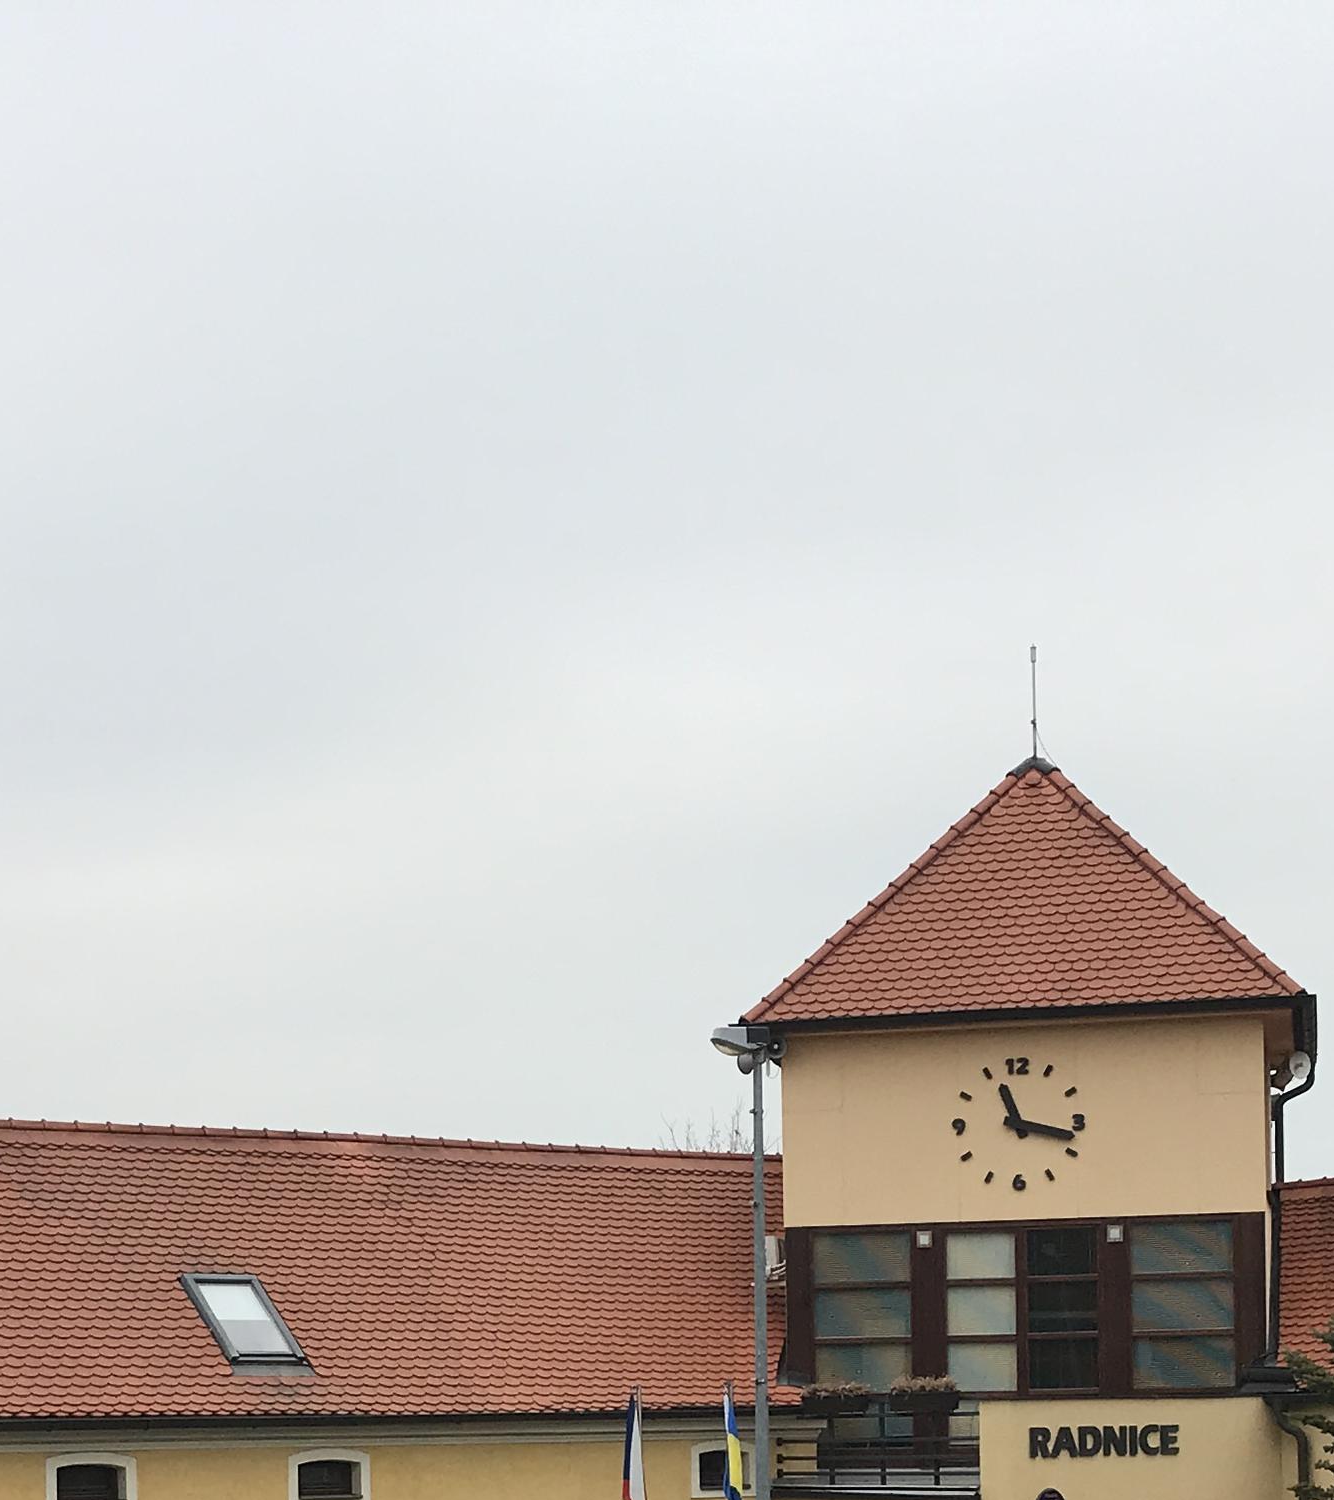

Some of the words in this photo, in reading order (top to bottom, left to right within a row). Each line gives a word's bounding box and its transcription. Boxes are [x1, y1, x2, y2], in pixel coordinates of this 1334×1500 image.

[1005, 1057, 1030, 1076] 12
[951, 1118, 966, 1136] 9
[1072, 1113, 1086, 1132] 3
[1012, 1174, 1027, 1191] 6
[1028, 1424, 1180, 1459] RADNICE
